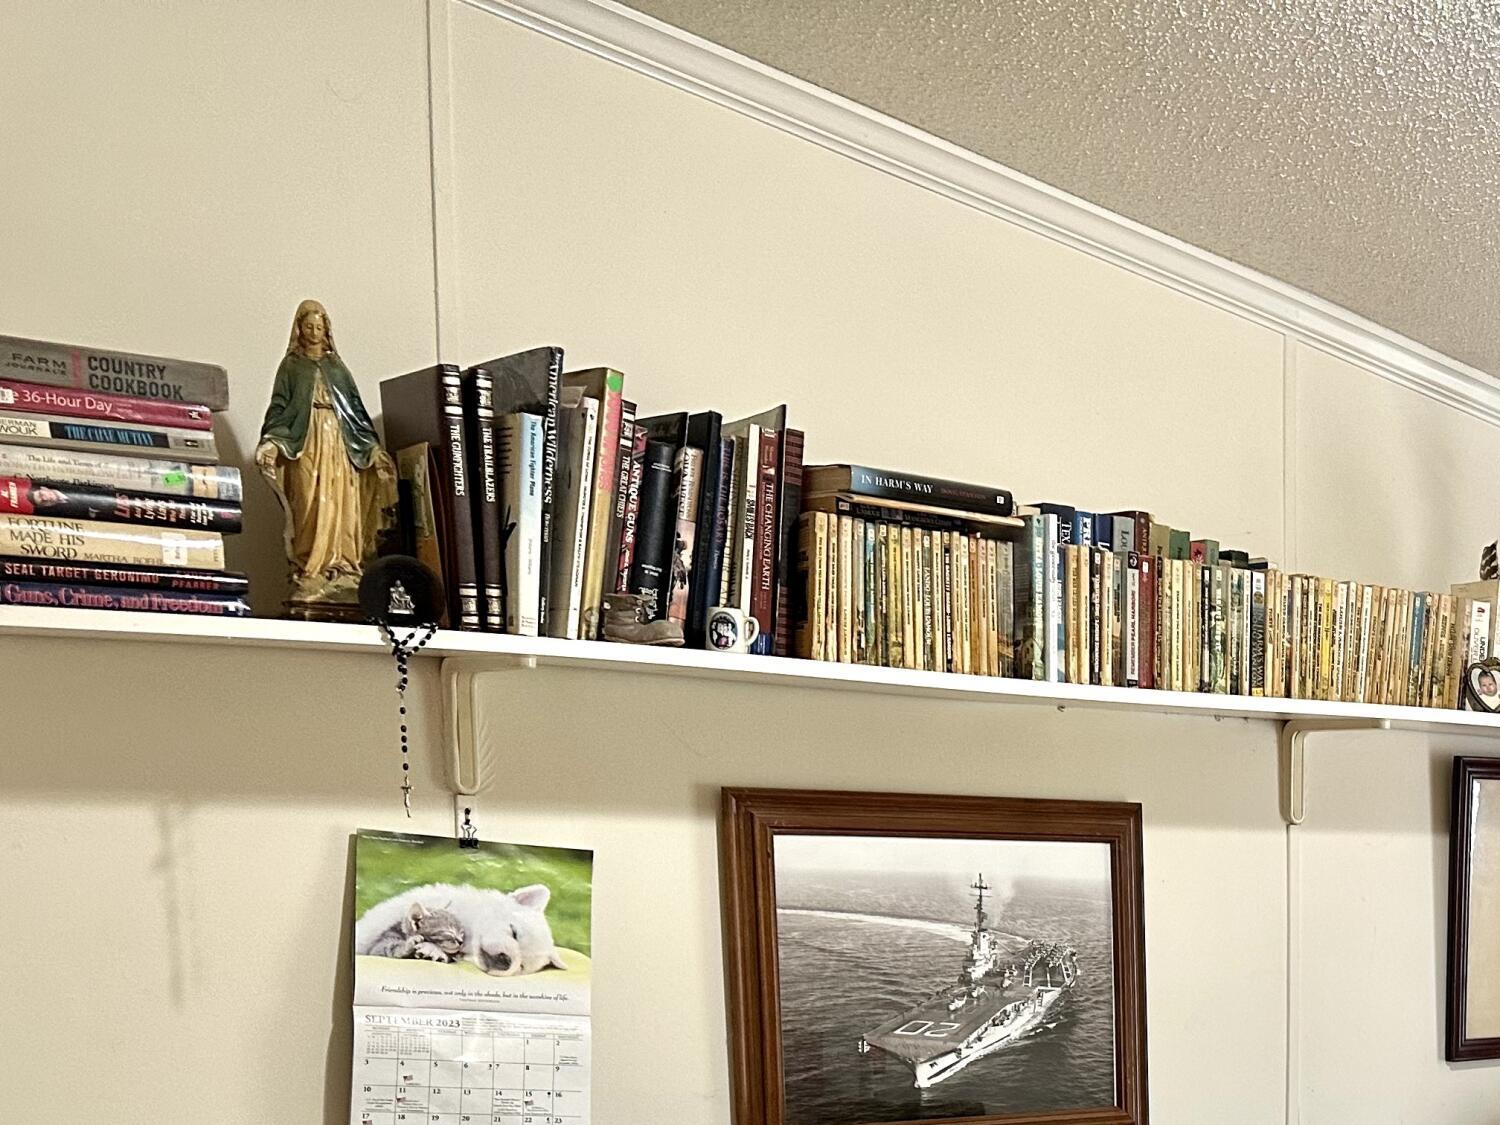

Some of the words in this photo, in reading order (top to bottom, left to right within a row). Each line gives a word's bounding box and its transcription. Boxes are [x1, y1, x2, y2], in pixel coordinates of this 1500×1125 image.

[11, 353, 66, 370] FARM
[87, 356, 167, 380] COUNTRY
[89, 374, 184, 400] COOKBOOK
[22, 390, 81, 408] 36-Hour
[85, 397, 112, 414] Day
[0, 419, 36, 428] ERMAN
[544, 428, 558, 505] Wilderness
[628, 461, 641, 512] ANTIQUE
[766, 483, 774, 502] THE
[861, 474, 872, 485] IN
[875, 476, 912, 491] HARM'S
[913, 483, 934, 494] WAY
[10, 529, 53, 544] MADE
[60, 533, 85, 546] HIS
[625, 513, 637, 544] GUNS
[763, 502, 773, 557] CHANGING
[20, 544, 78, 560] SWORD
[5, 562, 37, 577] SEAL
[42, 566, 89, 580] TARGET
[94, 569, 160, 584] GERONIMO
[762, 558, 771, 591] EARTH
[120, 593, 150, 611] and
[436, 1018, 461, 1028] 2023
